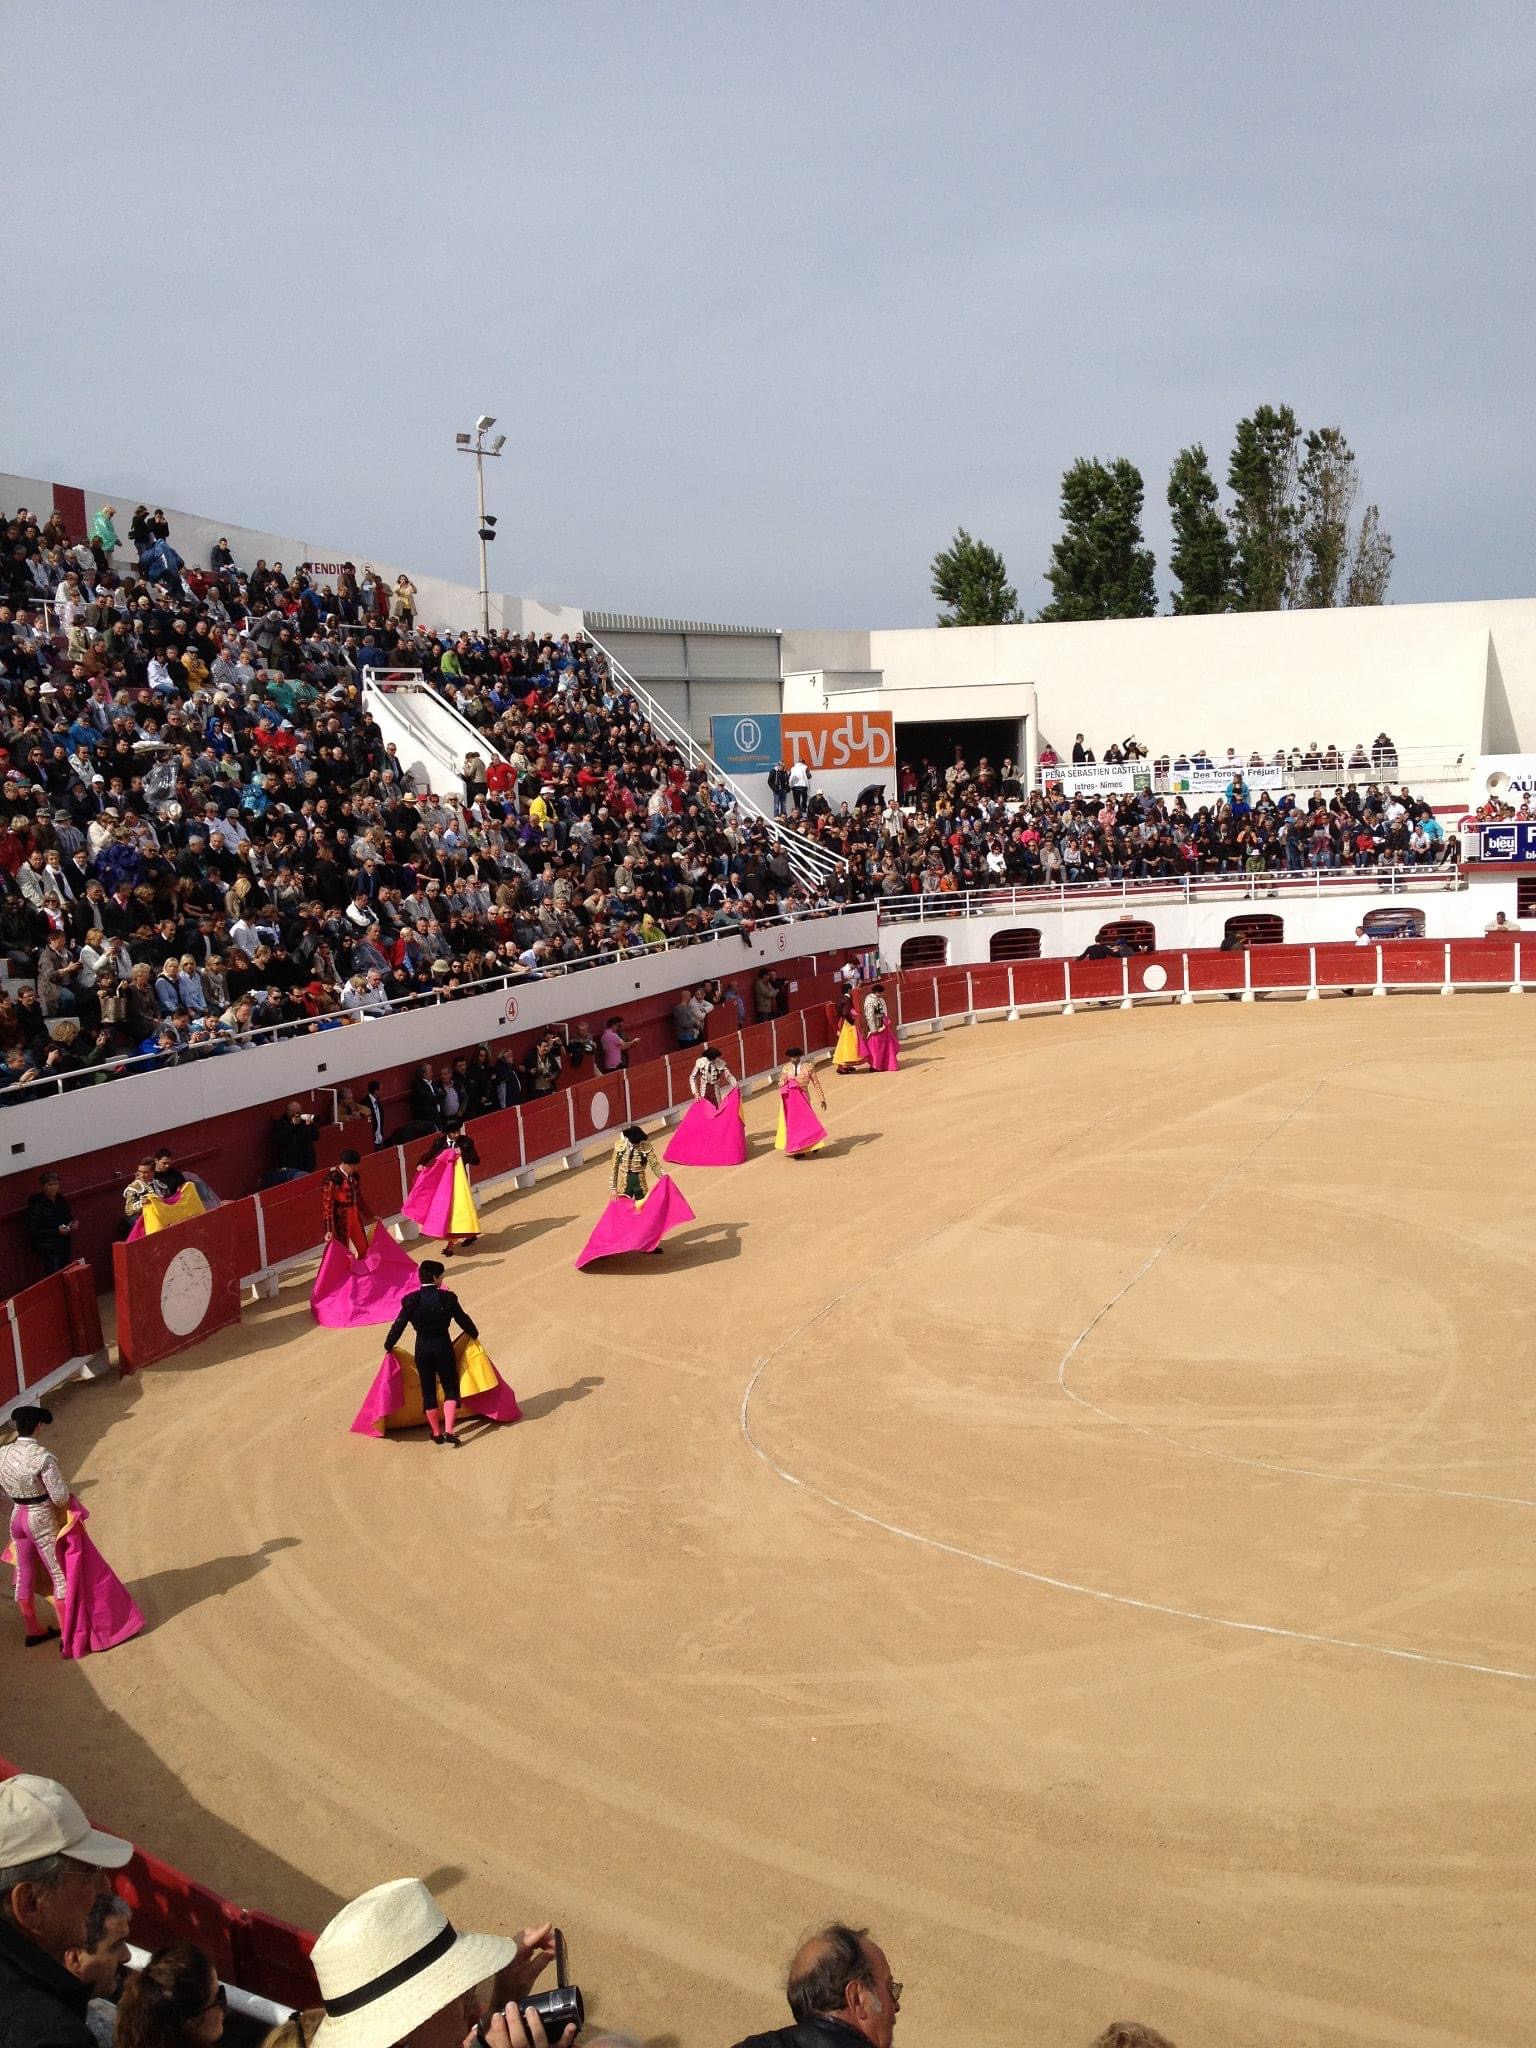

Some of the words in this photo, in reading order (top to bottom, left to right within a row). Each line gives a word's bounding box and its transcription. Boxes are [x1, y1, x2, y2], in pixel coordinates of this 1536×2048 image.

[1067, 766, 1110, 778] SEBASTIEN
[1111, 765, 1151, 775] CASTELLA
[1489, 837, 1515, 849] bleu
